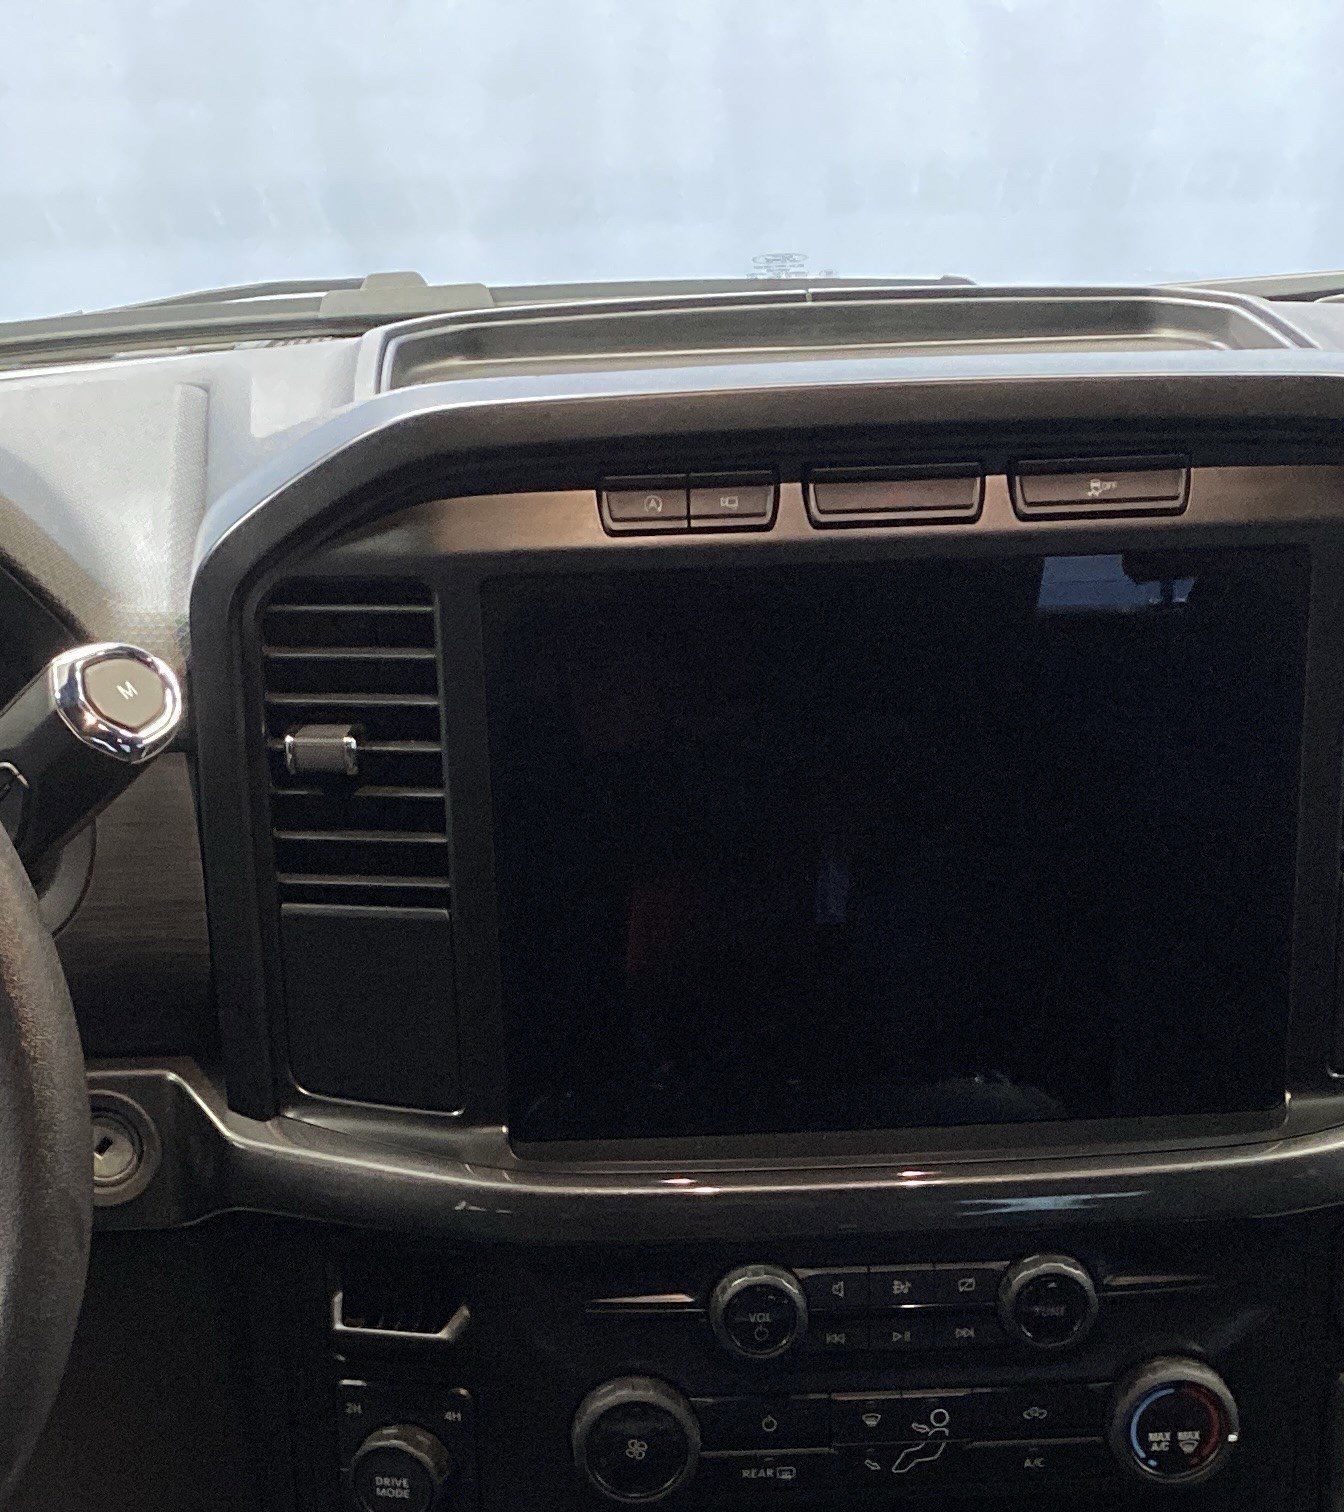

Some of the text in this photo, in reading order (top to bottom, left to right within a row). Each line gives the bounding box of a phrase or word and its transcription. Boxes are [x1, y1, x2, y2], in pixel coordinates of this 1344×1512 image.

[116, 680, 139, 700] M
[748, 1312, 772, 1323] VOL
[344, 1402, 362, 1415] 2H
[444, 1410, 462, 1422] 4H
[1148, 1431, 1171, 1441] MAX
[1177, 1430, 1200, 1440] MAX
[1151, 1441, 1170, 1451] A/C
[1024, 1457, 1045, 1469] A/C
[742, 1468, 774, 1479] REAR
[374, 1475, 410, 1489] DRIVE
[375, 1487, 411, 1499] MODE
